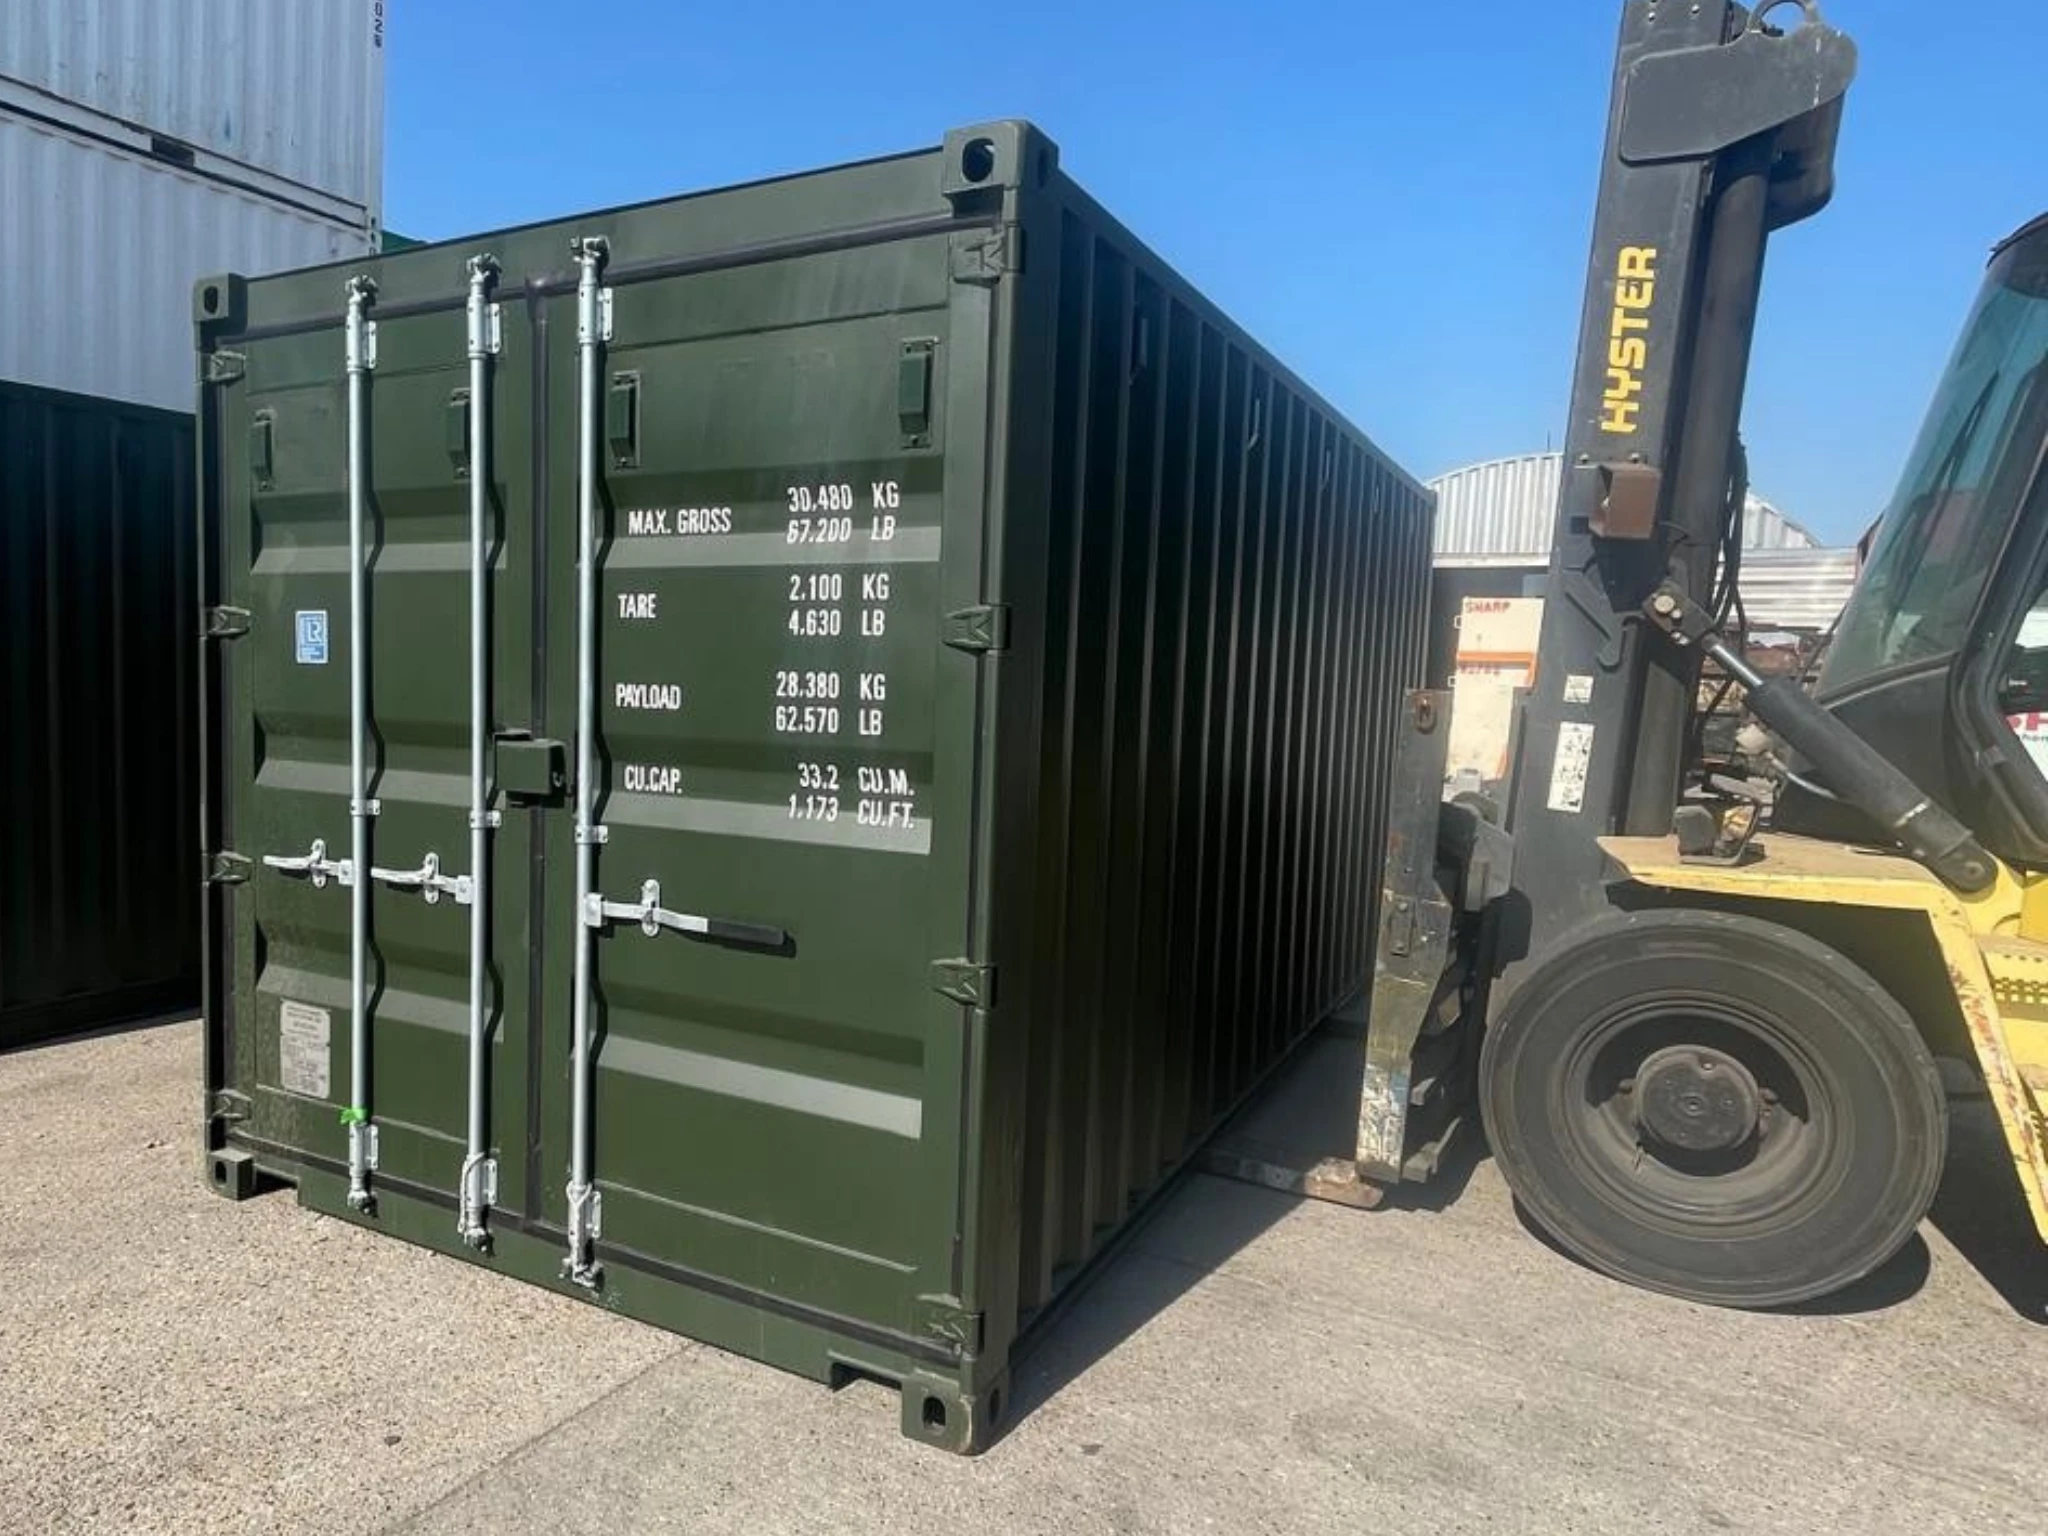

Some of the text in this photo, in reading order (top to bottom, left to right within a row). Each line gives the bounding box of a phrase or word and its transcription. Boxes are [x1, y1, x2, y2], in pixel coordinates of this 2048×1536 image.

[1601, 246, 1657, 433] HYSTER
[786, 481, 899, 512] 30.480 KG
[628, 507, 732, 535] MAX. GROSS
[786, 515, 895, 544] 67.200 LB
[789, 574, 890, 601] 2.100 KG
[618, 594, 656, 619] TARE
[1465, 601, 1511, 614] SHARP
[788, 610, 885, 636] 4.630 LB
[616, 684, 681, 710] PAYLOAD
[776, 671, 886, 700] 28.380 KG
[775, 706, 883, 735] 62.570 LB
[624, 765, 683, 794] CU.CAP.
[798, 762, 915, 796] 33.2 CU.M.
[789, 793, 914, 829] 1.173 CU.FT.
